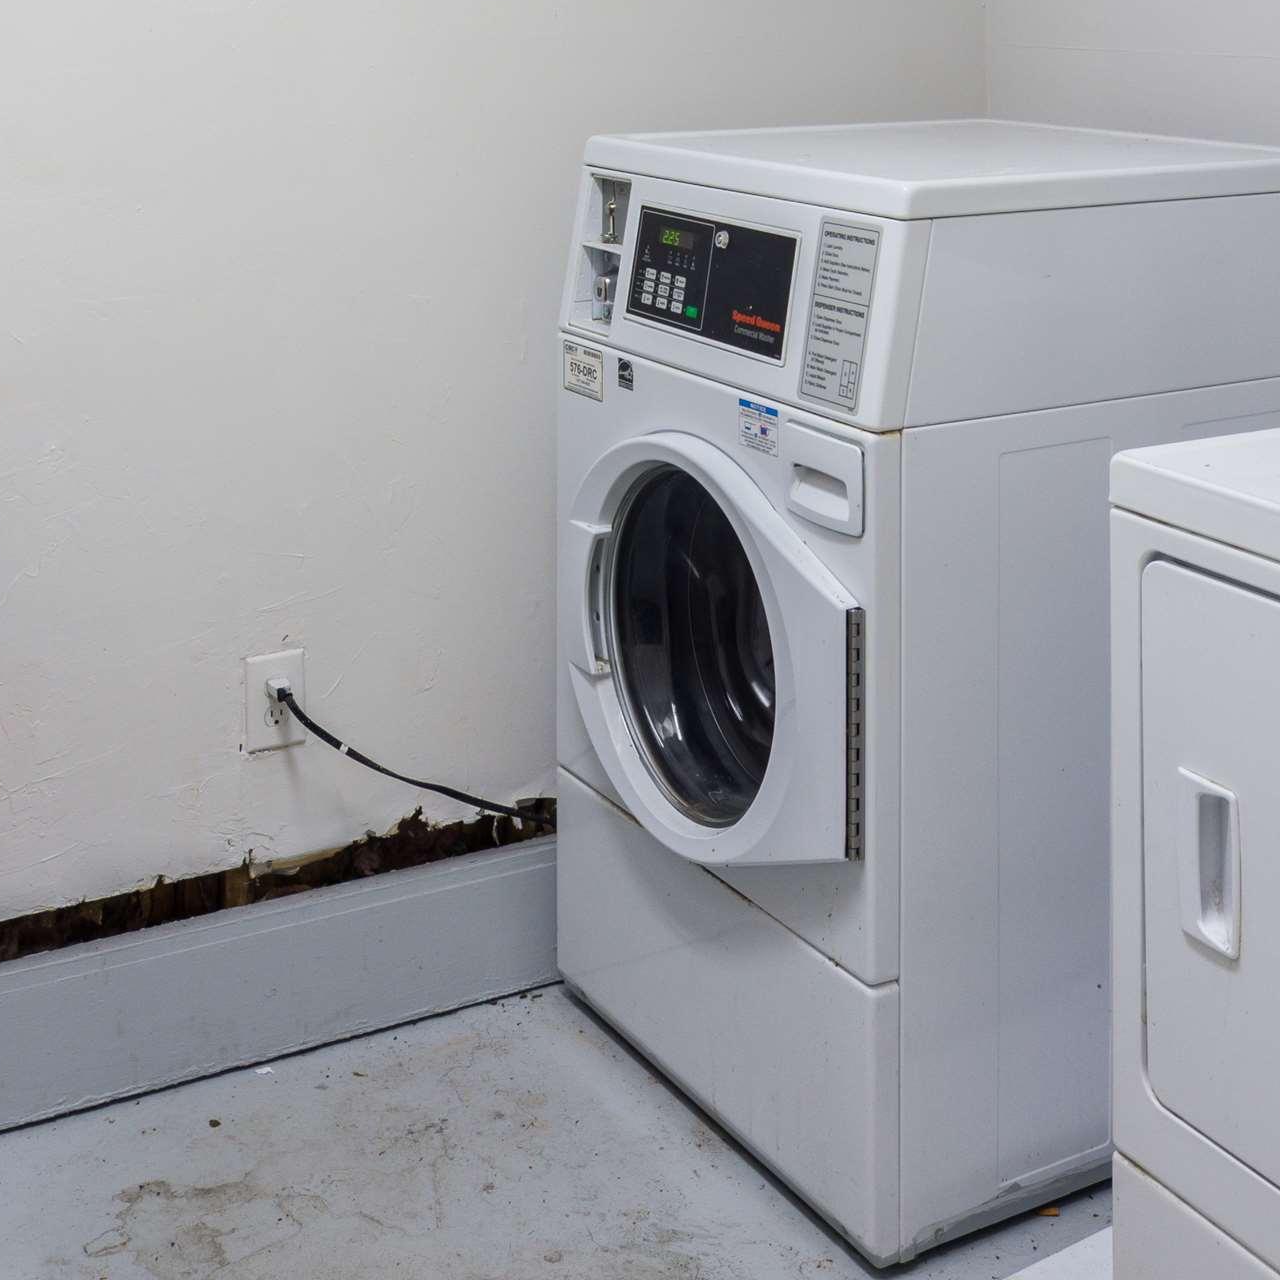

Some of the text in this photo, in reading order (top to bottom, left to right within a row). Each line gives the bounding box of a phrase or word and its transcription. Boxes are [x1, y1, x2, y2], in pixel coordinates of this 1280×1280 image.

[662, 230, 680, 246] 225
[732, 310, 781, 333] Speed Queen
[570, 361, 598, 381] 576-DRC
